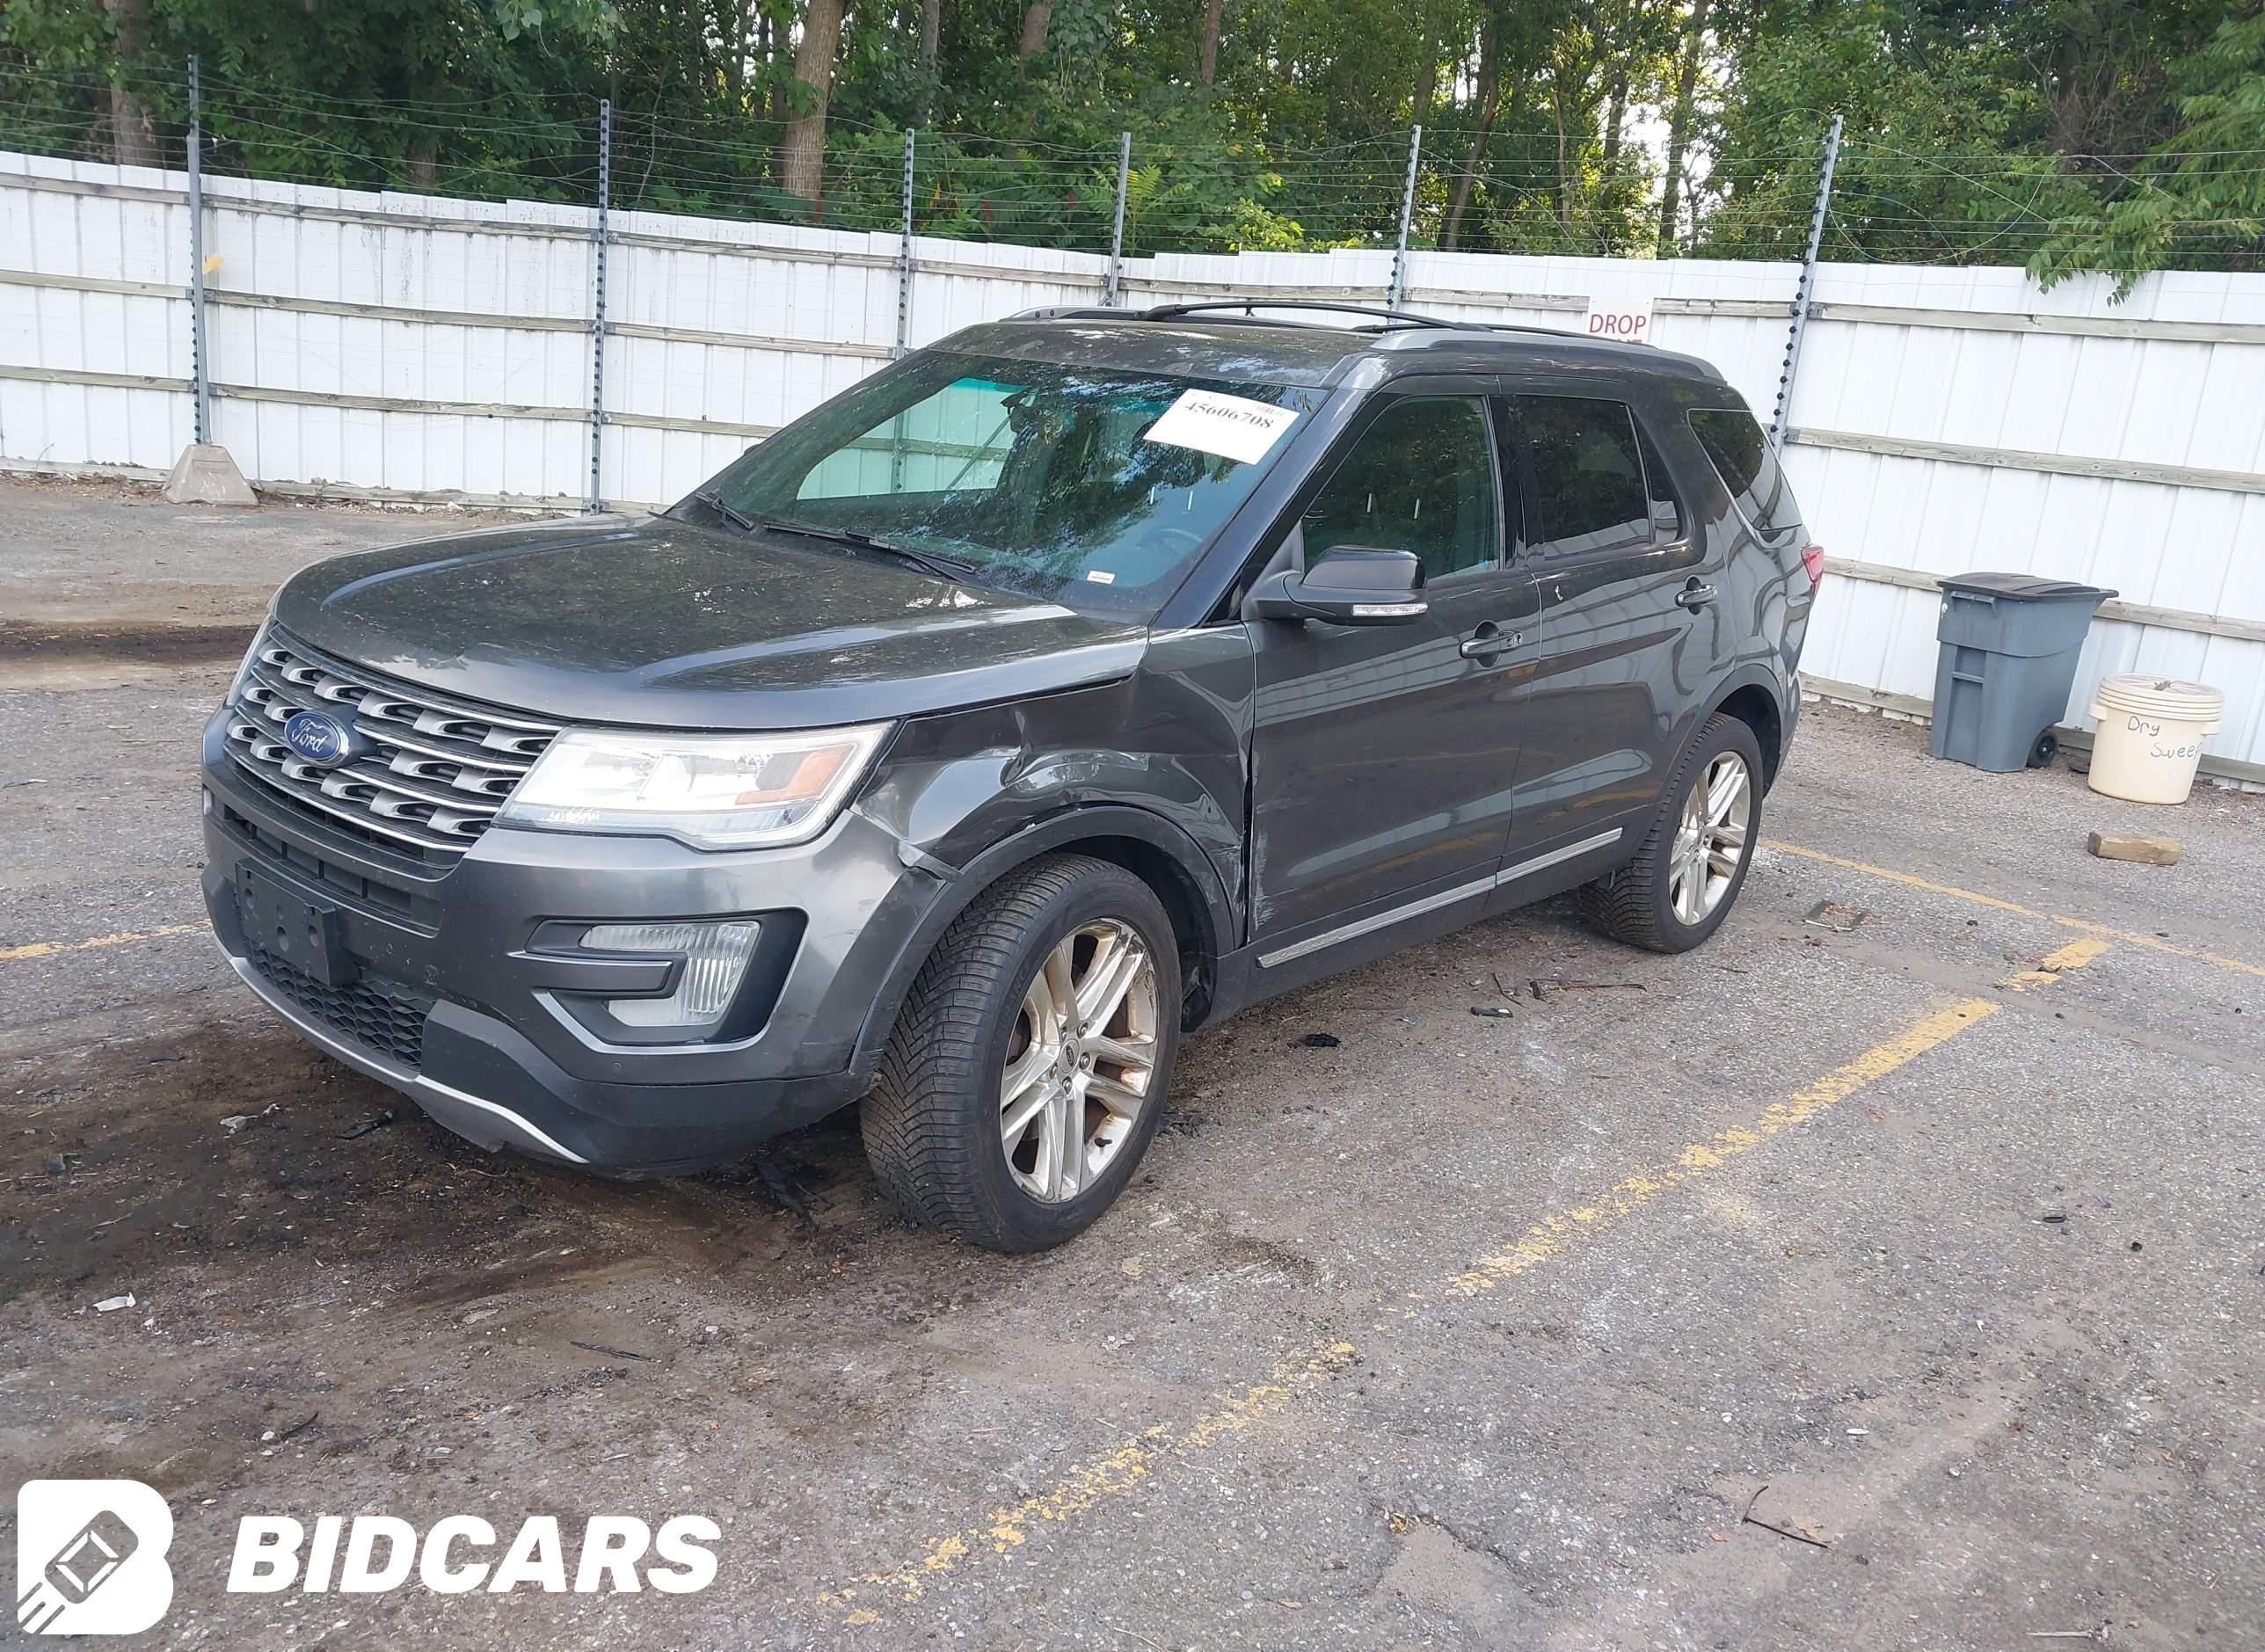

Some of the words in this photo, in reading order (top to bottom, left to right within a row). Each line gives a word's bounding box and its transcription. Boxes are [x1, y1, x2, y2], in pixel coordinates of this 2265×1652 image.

[1589, 314, 1647, 335] DROP
[1185, 402, 1274, 429] 45606708
[291, 718, 328, 752] Ford
[2127, 716, 2160, 737] Dry
